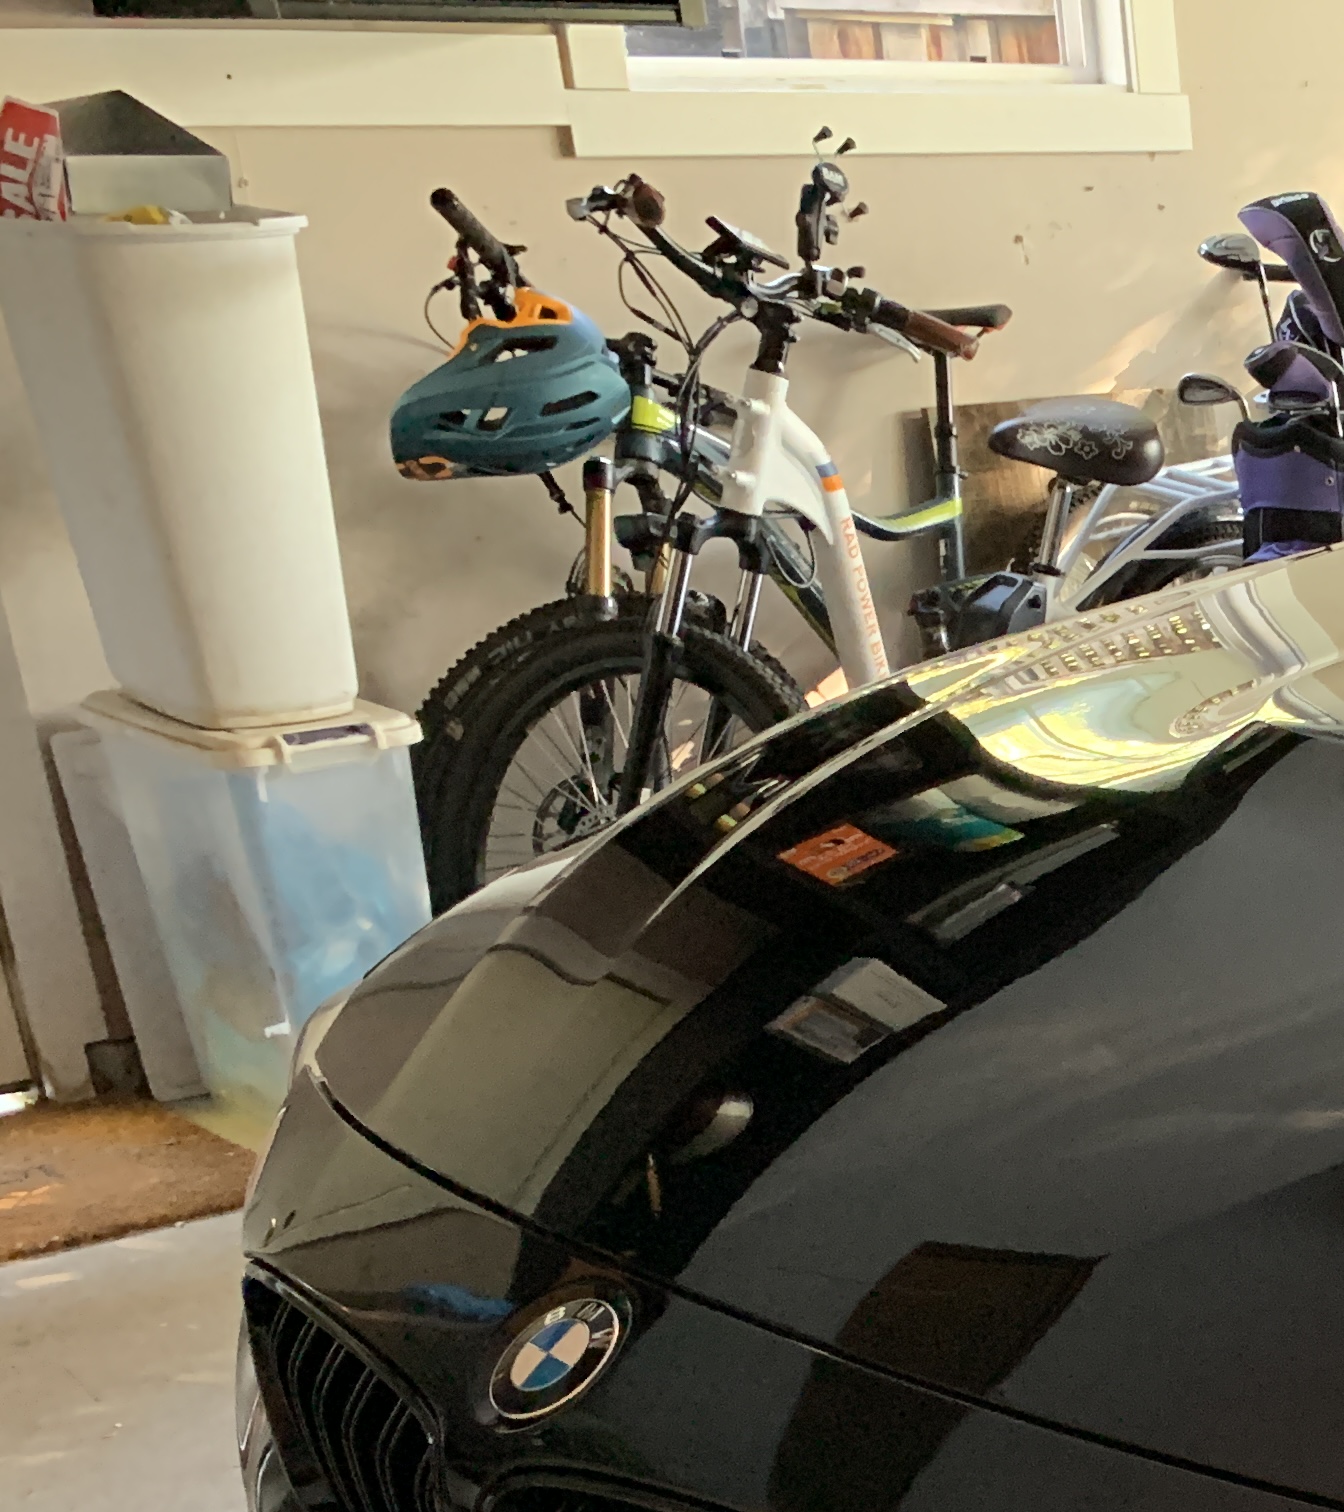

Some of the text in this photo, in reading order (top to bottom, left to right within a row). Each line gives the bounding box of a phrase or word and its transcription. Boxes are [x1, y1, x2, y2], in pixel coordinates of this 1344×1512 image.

[839, 516, 860, 560] RAD
[852, 563, 878, 638] POWER
[543, 1301, 615, 1350] BMW
